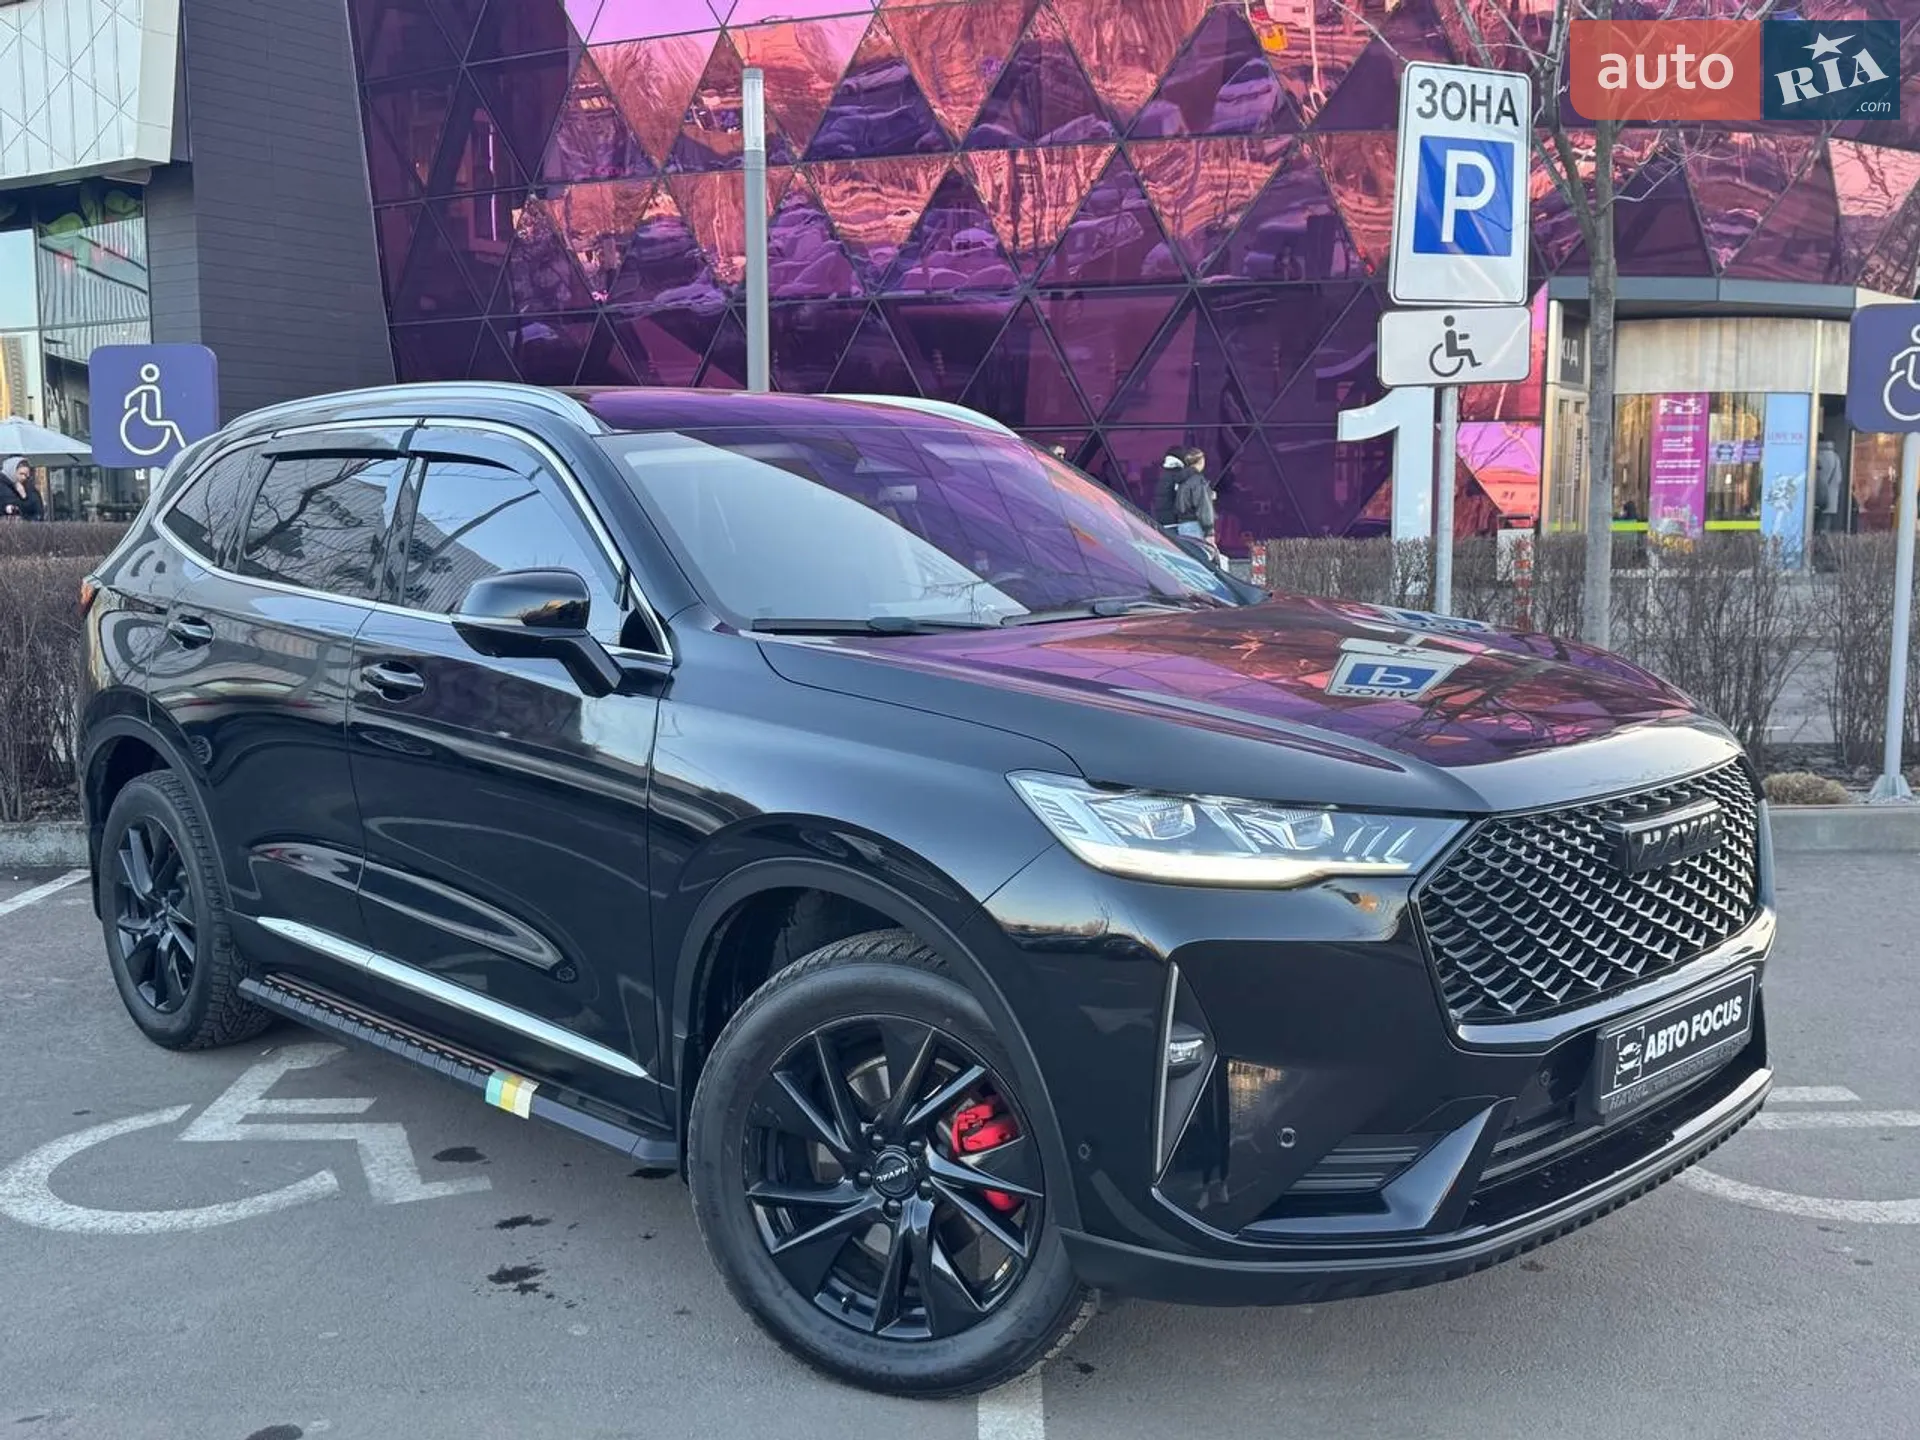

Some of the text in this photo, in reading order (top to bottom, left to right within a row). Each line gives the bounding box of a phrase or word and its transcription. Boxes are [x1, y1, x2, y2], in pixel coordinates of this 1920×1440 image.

[1415, 78, 1520, 127] ЗОНА
[1440, 148, 1497, 244] P
[1691, 995, 1742, 1042] FOCUS
